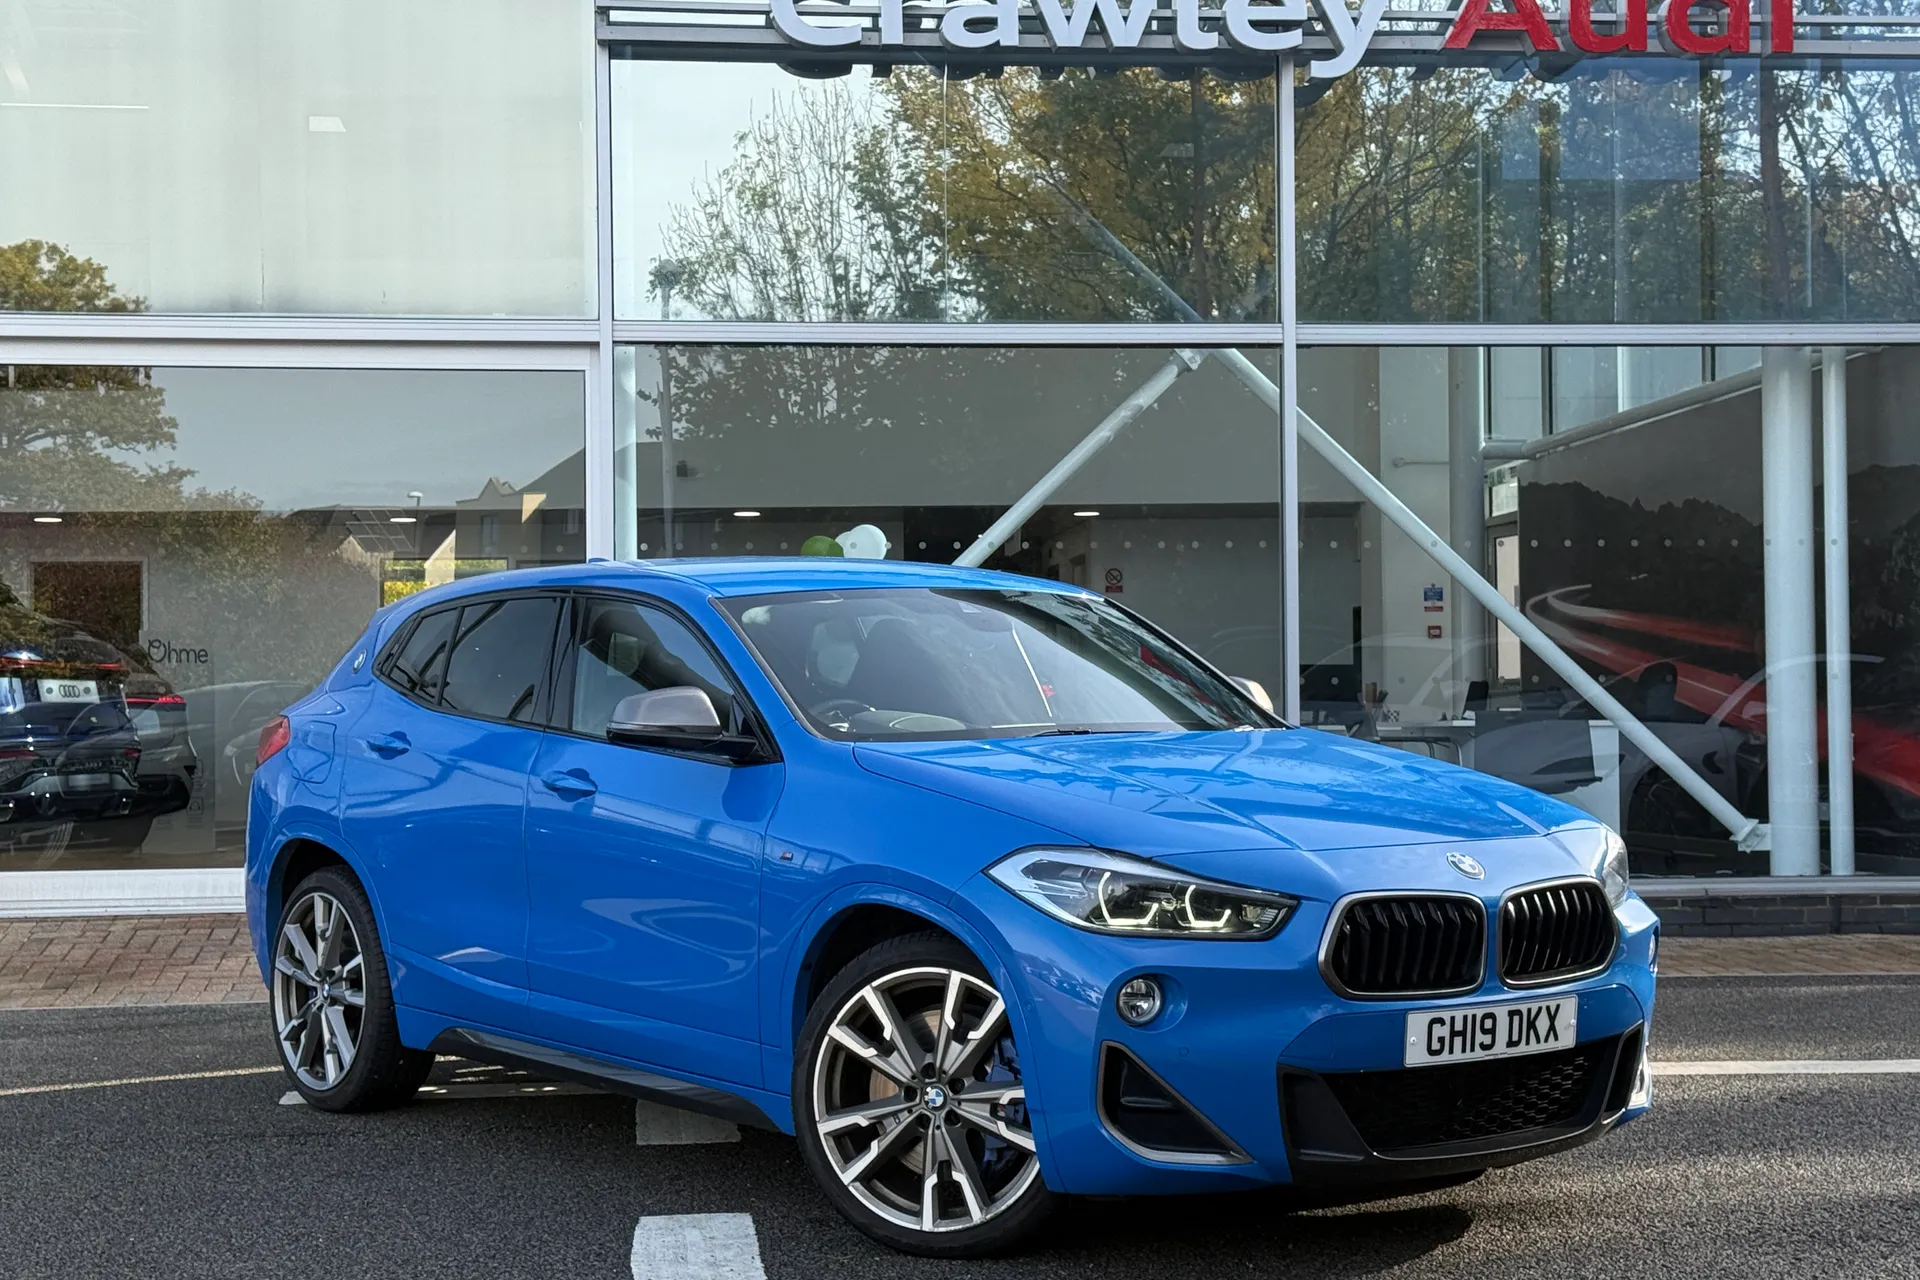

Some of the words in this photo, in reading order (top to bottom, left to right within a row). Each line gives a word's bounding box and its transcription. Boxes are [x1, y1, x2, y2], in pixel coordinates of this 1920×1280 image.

[147, 638, 209, 664] Ohme
[1425, 1012, 1498, 1057] GH19
[1505, 1003, 1562, 1049] DKX
